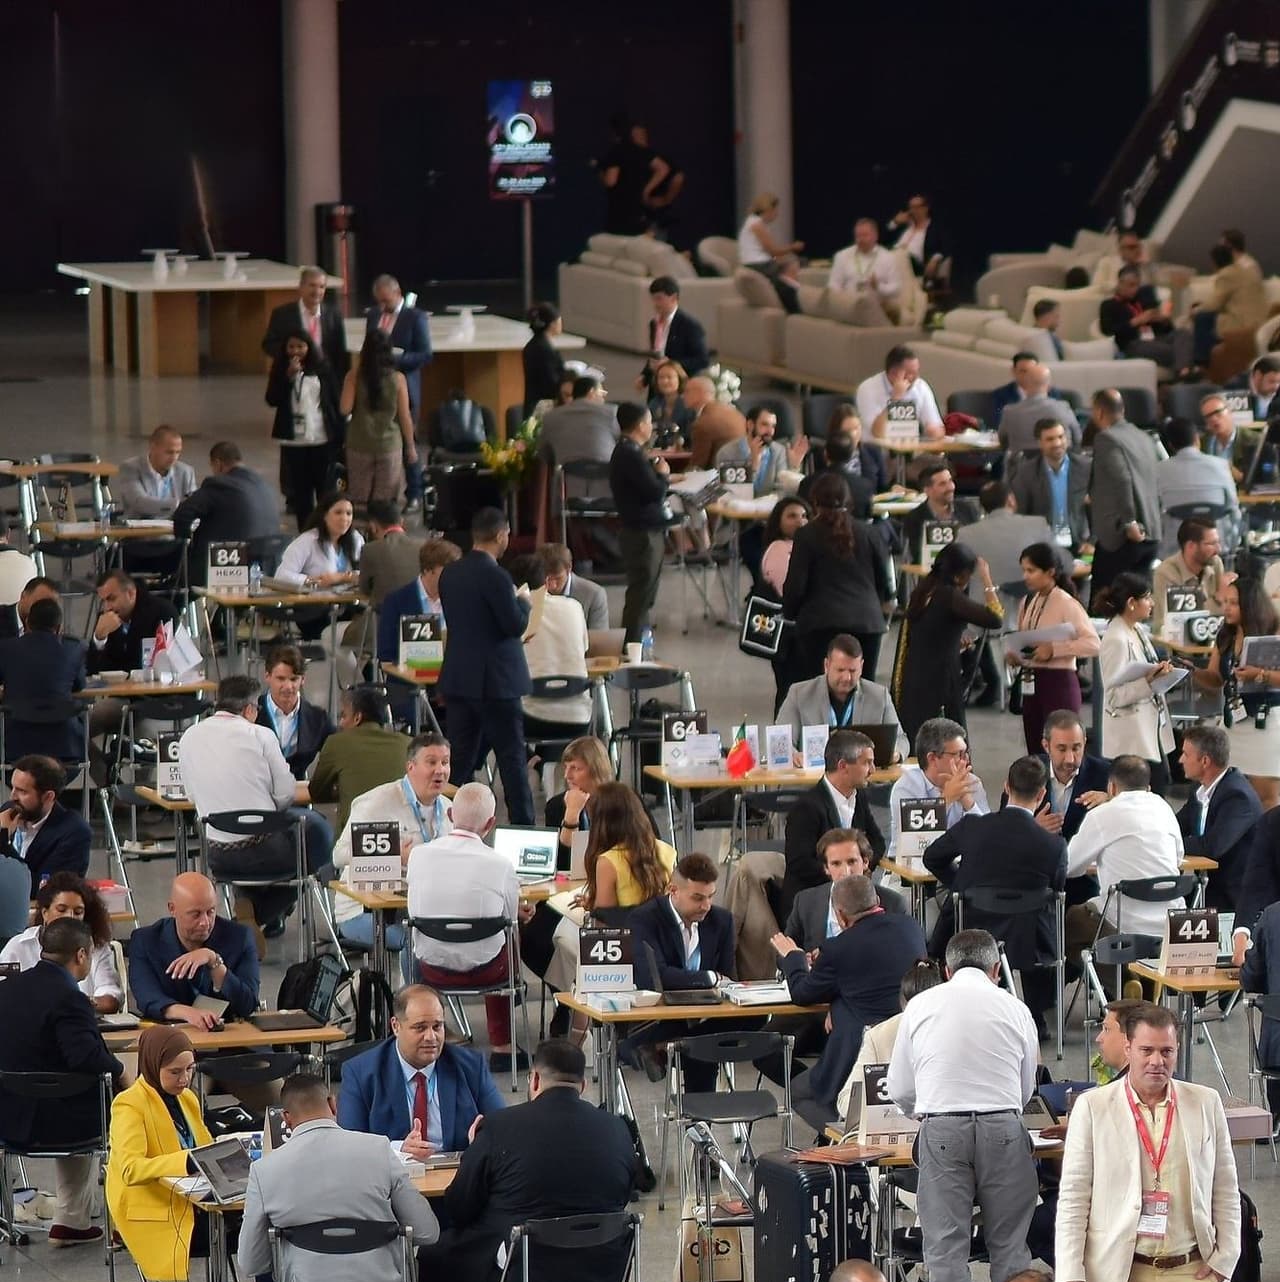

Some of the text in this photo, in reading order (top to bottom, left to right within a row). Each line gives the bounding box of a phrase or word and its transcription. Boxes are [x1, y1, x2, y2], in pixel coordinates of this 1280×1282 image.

[890, 406, 914, 419] 102
[726, 467, 747, 483] 93
[932, 528, 954, 543] 83
[217, 549, 241, 565] 84
[1174, 594, 1197, 610] 73
[410, 623, 434, 640] 74
[673, 721, 699, 739] 64
[168, 742, 180, 760] 6
[910, 809, 939, 829] 54
[362, 833, 391, 854] 55
[354, 864, 391, 873] acsono
[1179, 919, 1210, 940] 44
[590, 940, 623, 962] 45
[584, 972, 628, 985] kuraray
[876, 1077, 891, 1101] 3
